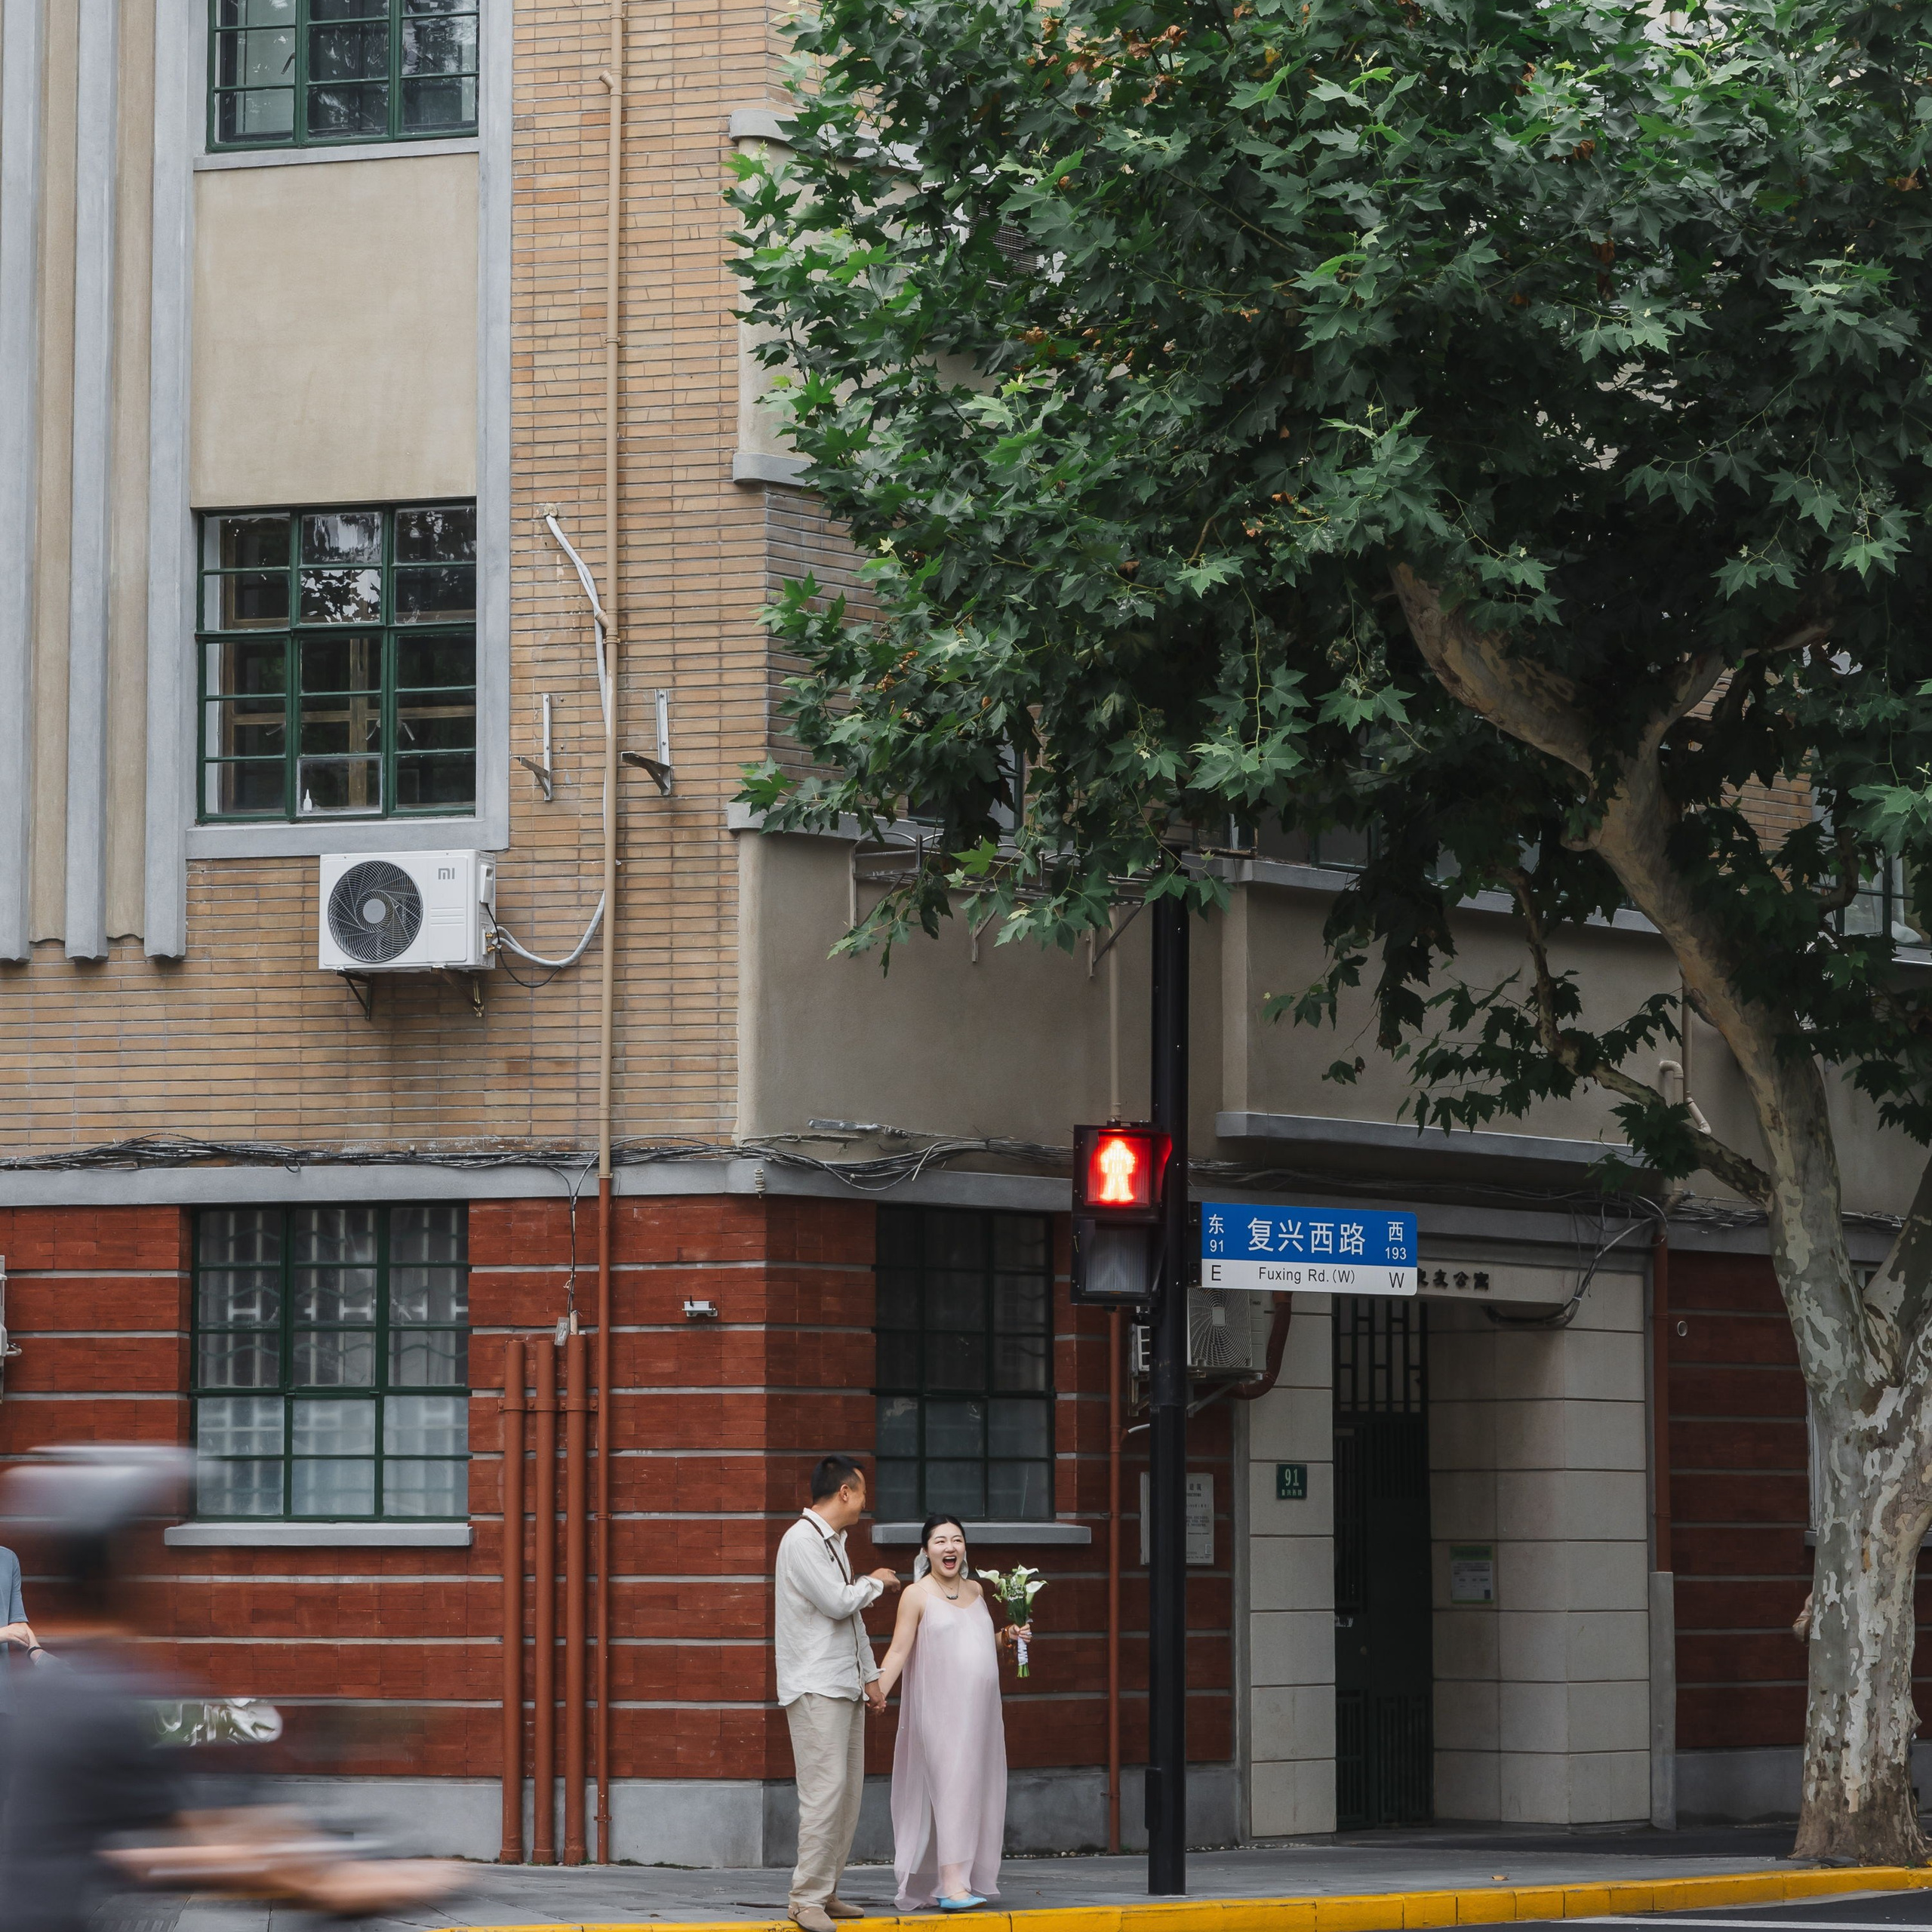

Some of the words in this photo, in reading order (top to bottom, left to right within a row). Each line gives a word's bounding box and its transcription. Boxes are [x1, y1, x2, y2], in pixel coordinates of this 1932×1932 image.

[1208, 1214, 1224, 1235] 东
[1247, 1217, 1366, 1256] 复兴西路
[1387, 1221, 1404, 1242] 西
[1210, 1239, 1223, 1253] 91
[1385, 1247, 1407, 1260] 193
[1211, 1264, 1222, 1281] E
[1259, 1266, 1301, 1284] Fuxing
[1389, 1272, 1404, 1289] W
[1284, 1468, 1300, 1487] 91
